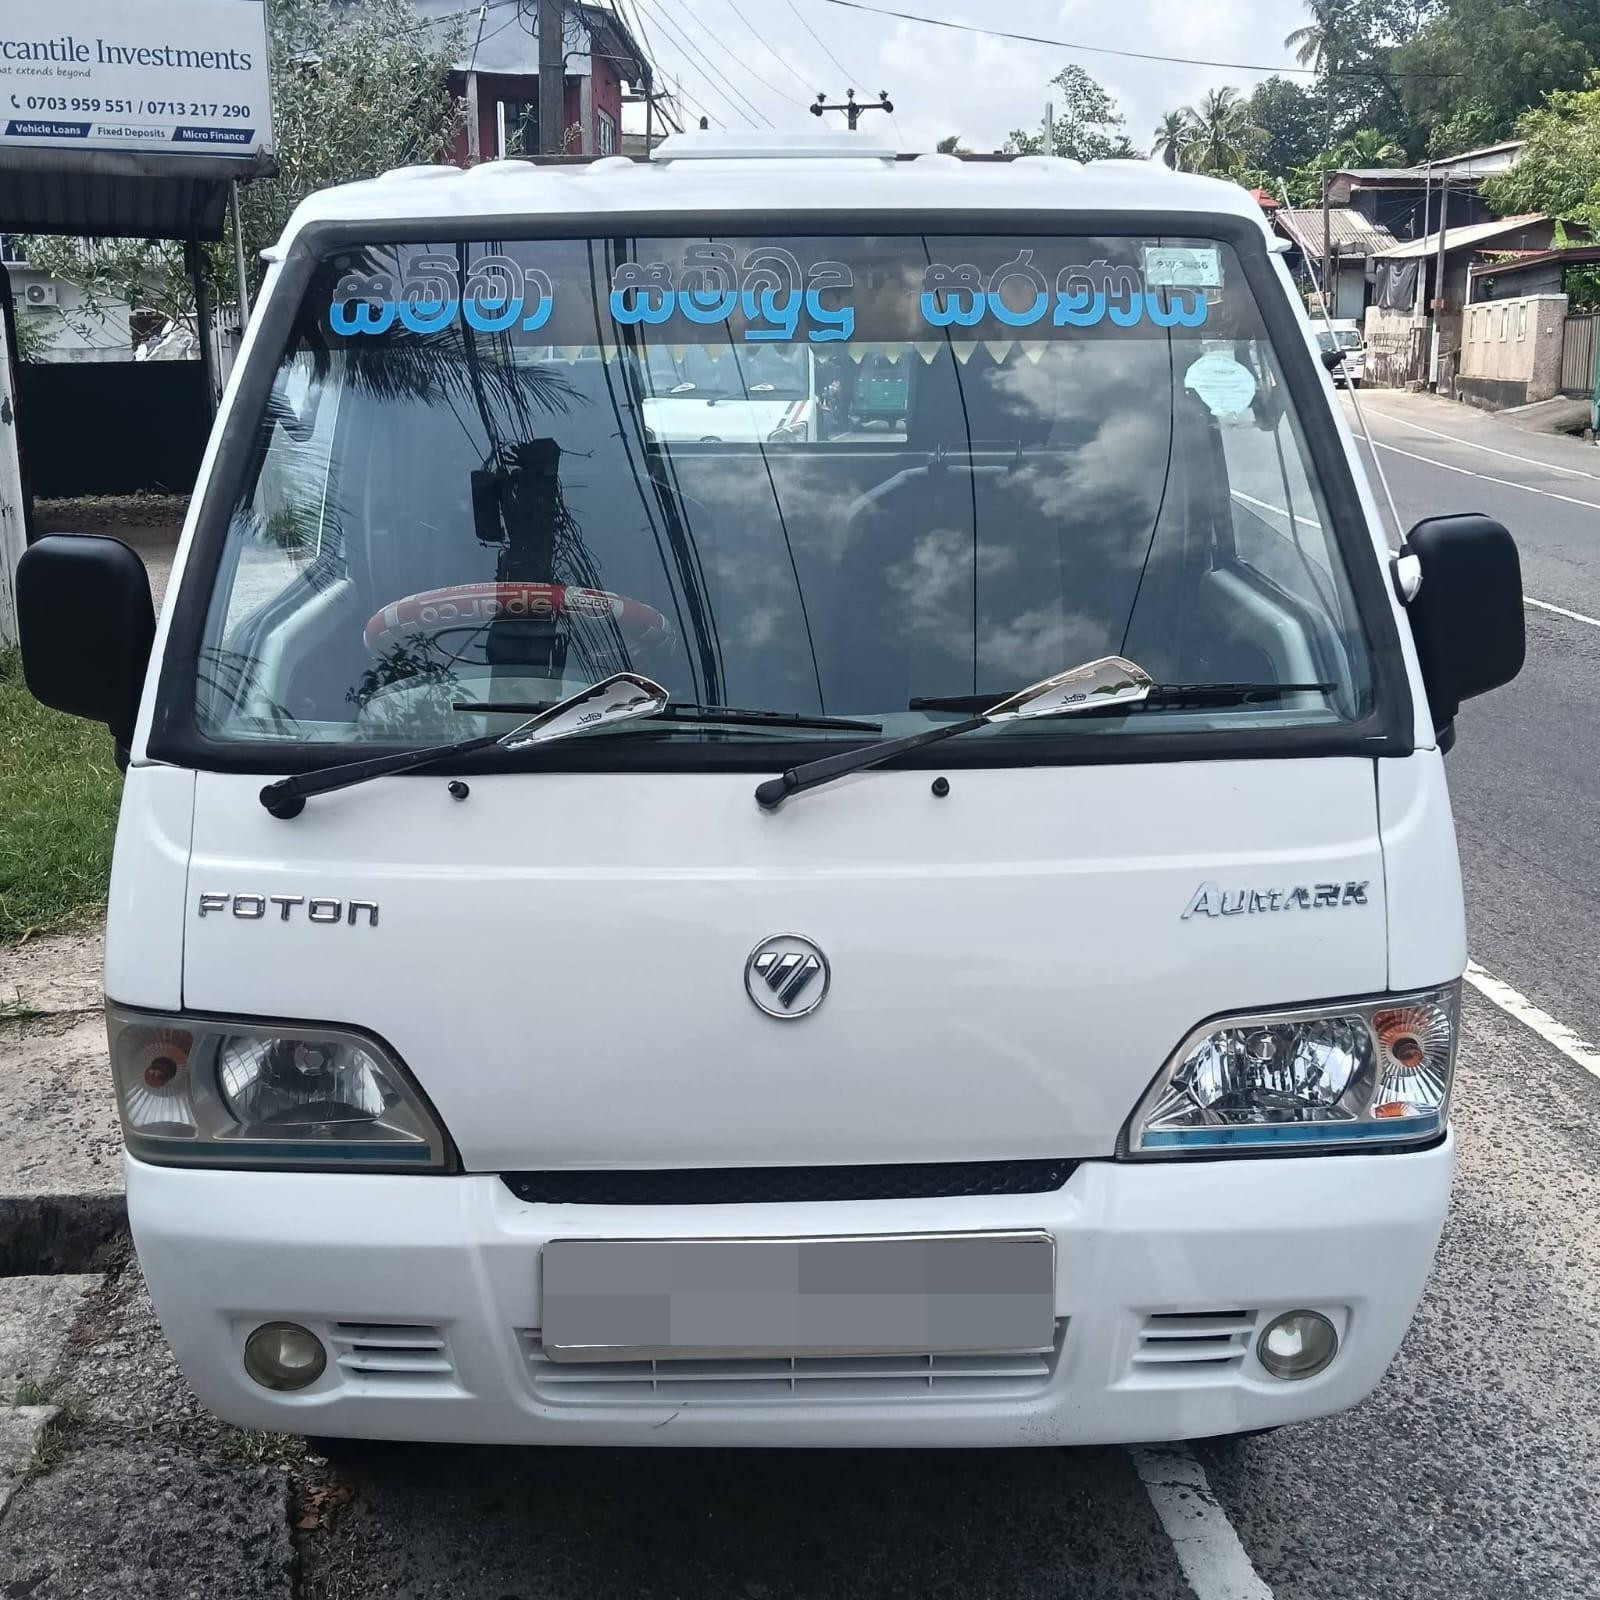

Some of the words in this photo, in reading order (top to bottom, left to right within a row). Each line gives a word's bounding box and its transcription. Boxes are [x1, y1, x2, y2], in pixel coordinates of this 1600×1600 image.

[96, 38, 252, 71] Investments
[16, 66, 53, 76] extends
[57, 67, 91, 79] beyond
[27, 96, 67, 111] 0703
[71, 98, 100, 112] 959
[105, 100, 132, 113] 551
[147, 101, 186, 115] 0713
[190, 103, 218, 116] 217
[222, 104, 251, 118] 290
[16, 124, 51, 134] Vehicle
[52, 125, 81, 135] Loans
[97, 127, 123, 136] Fixed
[125, 128, 165, 138] Deposits
[182, 130, 208, 140] Micro
[210, 131, 245, 141] Finance
[330, 254, 553, 336] සම්මා
[609, 242, 855, 342] සම්බුදු
[198, 892, 379, 927] FOTON
